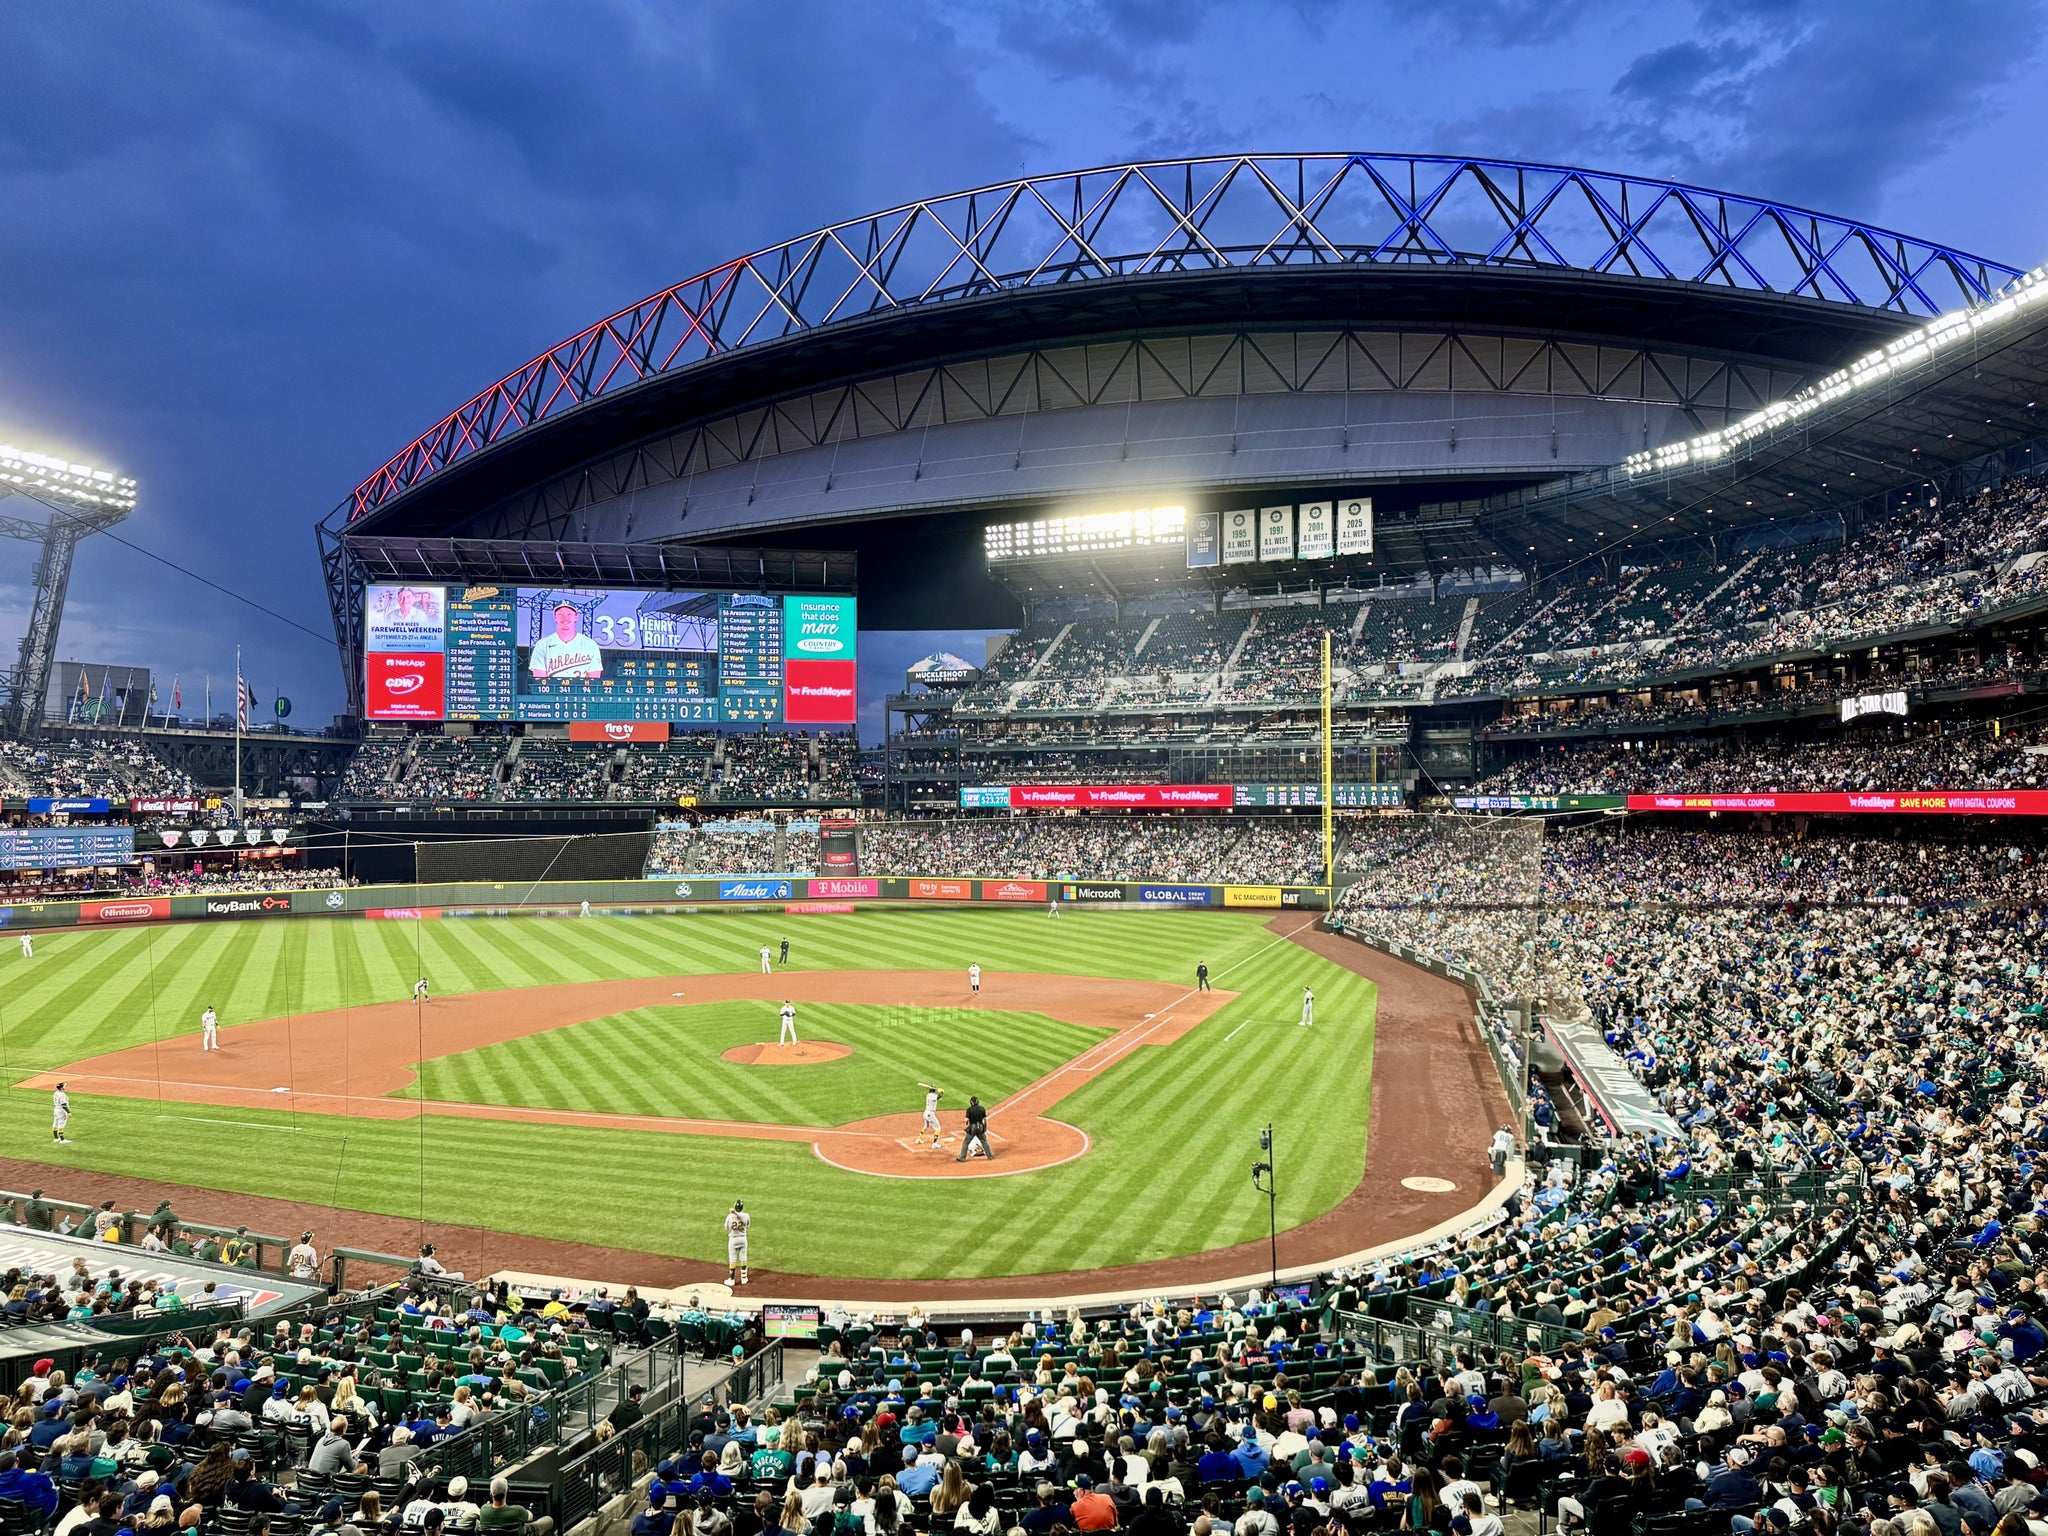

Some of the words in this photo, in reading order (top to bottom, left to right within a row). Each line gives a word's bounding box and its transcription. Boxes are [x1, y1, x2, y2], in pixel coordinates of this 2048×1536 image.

[1308, 522, 1324, 532] 2001
[1347, 519, 1363, 528] 2025
[1232, 529, 1247, 538] 1995
[1269, 526, 1284, 535] 1997
[1274, 536, 1288, 545] WEST
[1313, 533, 1328, 541] WEST
[1237, 540, 1251, 548] WEST
[1300, 543, 1331, 552] CHAMPIONS
[1340, 540, 1370, 549] CHAMPIONS
[1225, 549, 1254, 559] CHAMPIONS
[1262, 546, 1292, 556] CHAMPIONS
[801, 603, 840, 611] Insurance
[640, 617, 674, 632] HENRY
[801, 622, 838, 635] more
[594, 615, 636, 647] 33
[548, 654, 590, 672] Athletics
[916, 670, 968, 678] MUCKLESHOOT
[385, 678, 414, 688] CDW
[278, 699, 284, 715] P
[1883, 692, 1907, 716] CLUB
[680, 706, 688, 718] 0
[693, 706, 701, 718] 2
[707, 706, 712, 718] 1
[605, 723, 622, 733] fire
[624, 724, 634, 734] tv
[206, 798, 221, 809] 0:09
[981, 796, 1008, 804] $23,270
[1748, 799, 1775, 807] COUPONS
[1900, 798, 1921, 808] SAVE
[1922, 798, 1946, 808] MORE
[1948, 798, 1964, 808] WITH
[1965, 798, 1986, 808] DIGITAL
[1987, 798, 2015, 808] COUPONS
[724, 884, 768, 897] Alaska
[831, 882, 868, 893] Mobile
[1079, 889, 1121, 899] Microsoft
[1144, 891, 1186, 900] GLOBAL
[1282, 894, 1299, 904] CAT
[208, 900, 261, 912] KeyBank
[105, 907, 147, 917] Nintendo
[98, 1220, 105, 1229] 12
[732, 1221, 744, 1231] 22
[293, 1254, 304, 1264] 20
[754, 1456, 784, 1470] ANDERSON
[408, 1513, 421, 1524] 51
